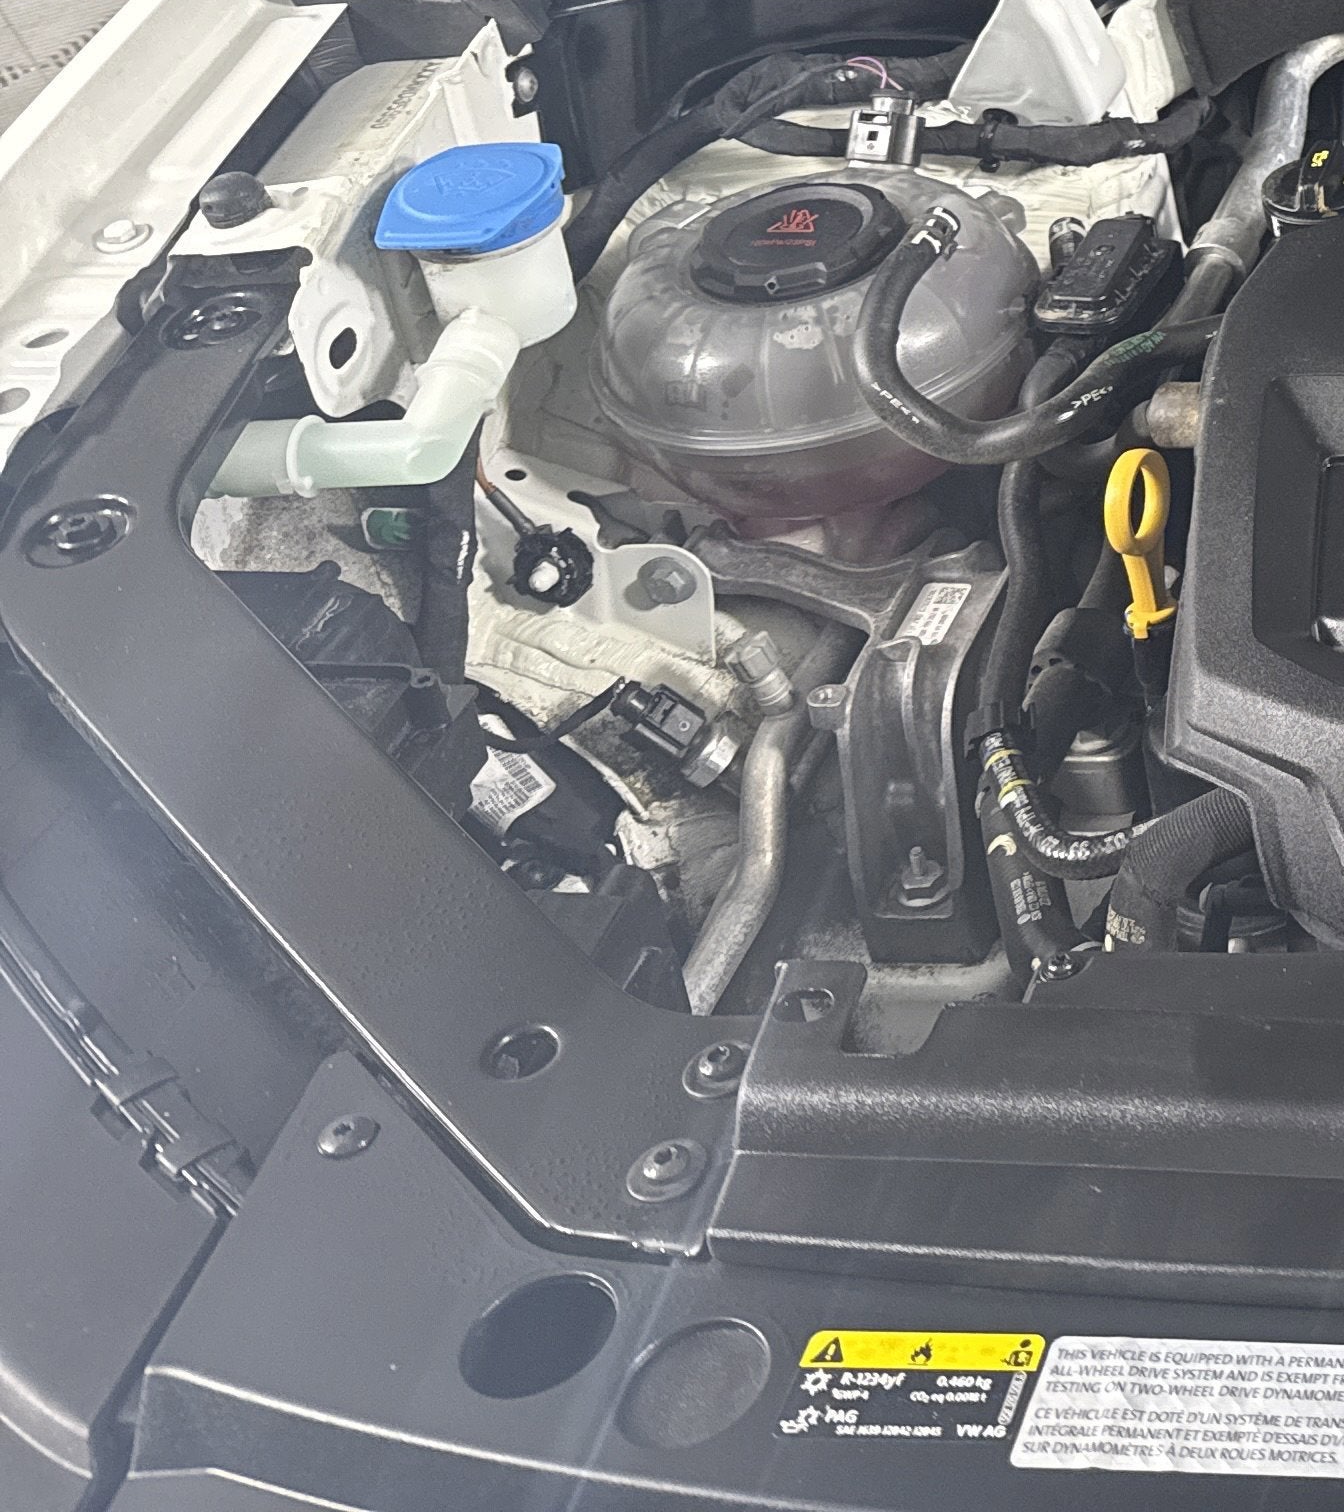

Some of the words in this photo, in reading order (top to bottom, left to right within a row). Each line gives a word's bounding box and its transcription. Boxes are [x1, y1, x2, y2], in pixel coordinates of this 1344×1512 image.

[1057, 1348, 1087, 1360] THIS
[1091, 1349, 1146, 1362] VEHICLE
[1149, 1351, 1161, 1362] IS
[1164, 1351, 1233, 1365] EQUIPPED
[1236, 1354, 1271, 1366] WITH
[1275, 1355, 1287, 1367] A
[1050, 1365, 1125, 1377] ALL-WHEEL
[1128, 1366, 1169, 1379] DRIVE
[1173, 1368, 1224, 1381] SYSTEM
[1226, 1370, 1258, 1382] AND
[1261, 1371, 1274, 1382] IS
[1276, 1372, 1330, 1384] EXEMPT
[1046, 1380, 1101, 1393] TESTING
[1104, 1381, 1128, 1394] ON
[1129, 1382, 1214, 1397] TWO-WHEEL
[1218, 1385, 1261, 1398] DRIVE
[1035, 1408, 1054, 1419] CE
[1055, 1406, 1120, 1420] VÉHICULE
[1121, 1409, 1144, 1421] EST
[1147, 1409, 1184, 1423] DOTÉ
[1224, 1412, 1281, 1427] SYSTÈME
[1284, 1416, 1301, 1427] DE
[1028, 1423, 1100, 1437] INTÉGRALE
[1101, 1426, 1183, 1441] PERMANENT
[1184, 1428, 1199, 1441] ET
[1022, 1441, 1048, 1454] SUR
[1051, 1441, 1164, 1457] DYNAMOMÈTRES
[1178, 1446, 1218, 1459] DEUX
[1220, 1448, 1266, 1461] ROUES
